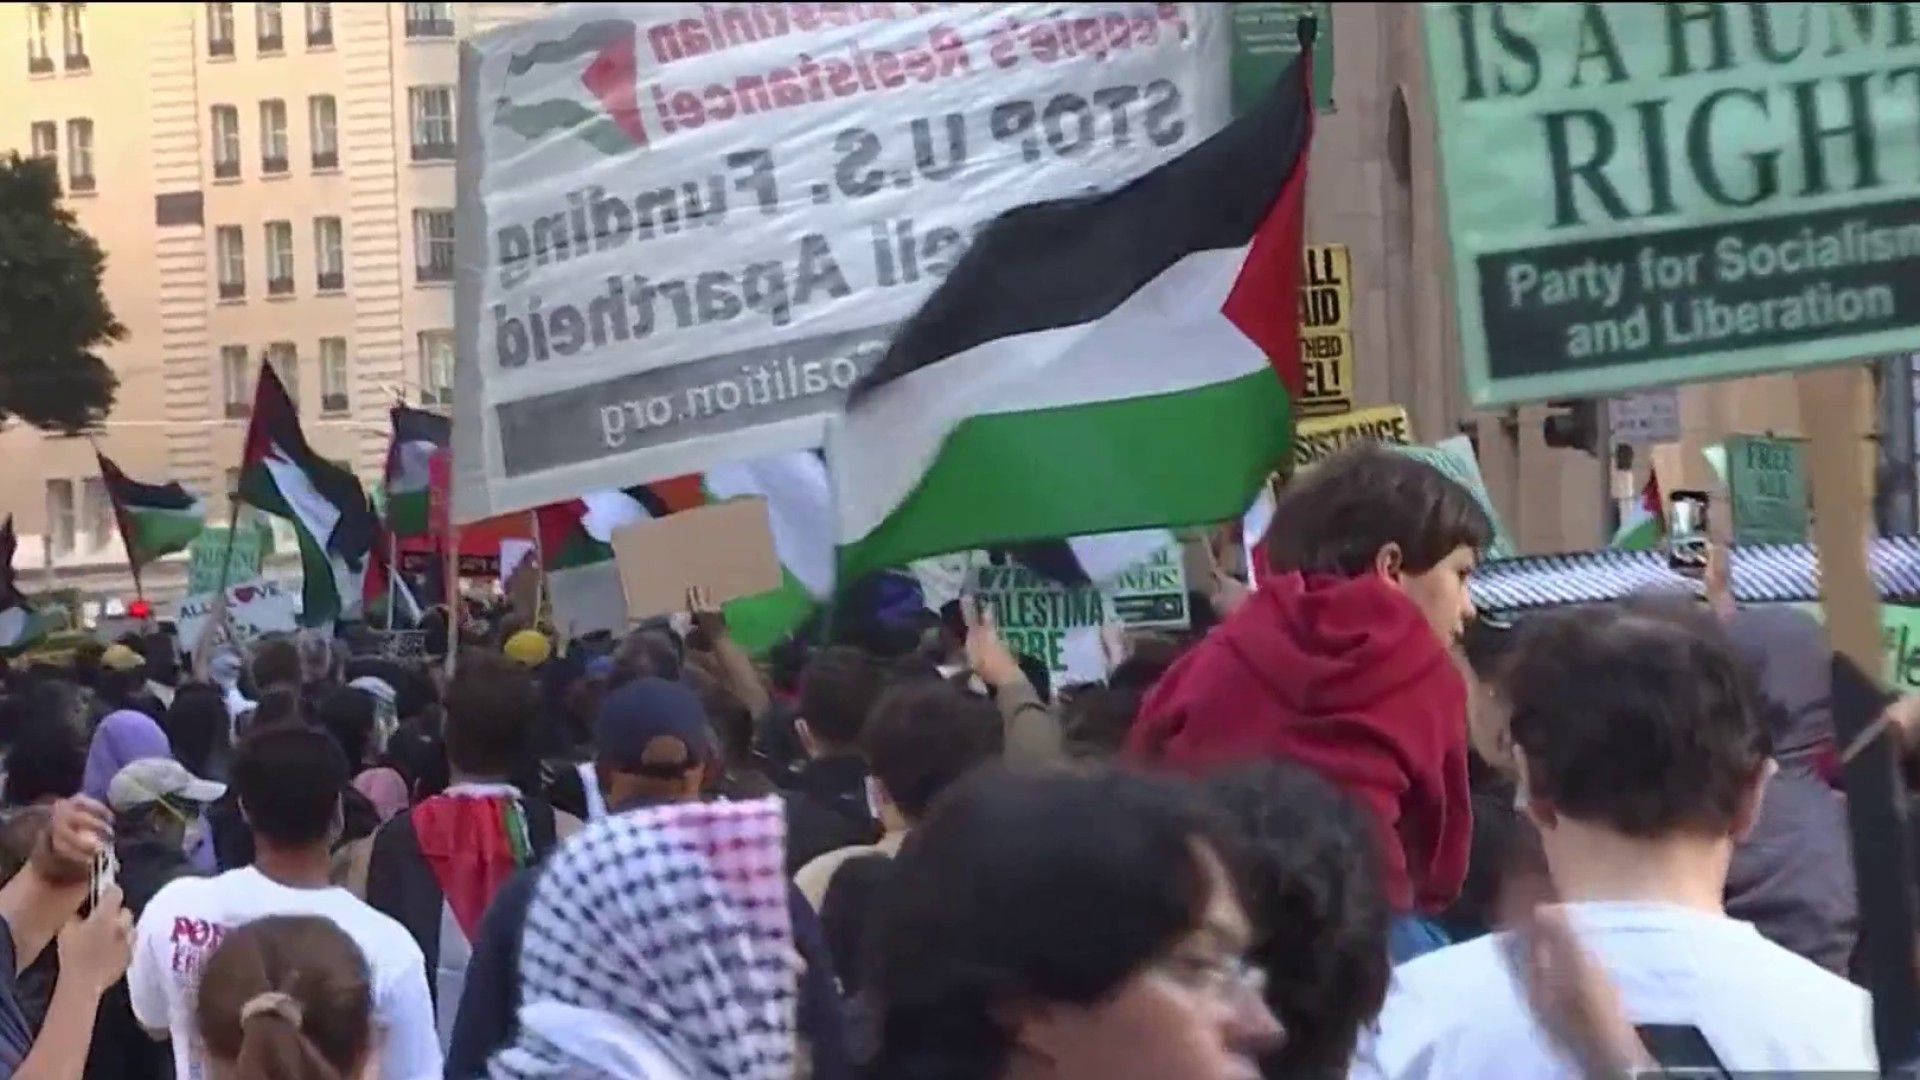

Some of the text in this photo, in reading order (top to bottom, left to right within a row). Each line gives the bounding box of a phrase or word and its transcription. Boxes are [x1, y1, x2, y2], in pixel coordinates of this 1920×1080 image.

[1451, 5, 1541, 100] IS
[1565, 5, 1631, 88] A
[1303, 247, 1342, 286] LL
[1506, 257, 1625, 308] Party
[1639, 247, 1701, 291] for
[1566, 282, 1895, 359] and Liberation
[1303, 360, 1342, 398] EL!
[1295, 416, 1412, 465] SISTANCE
[1004, 631, 1069, 672] BRE
